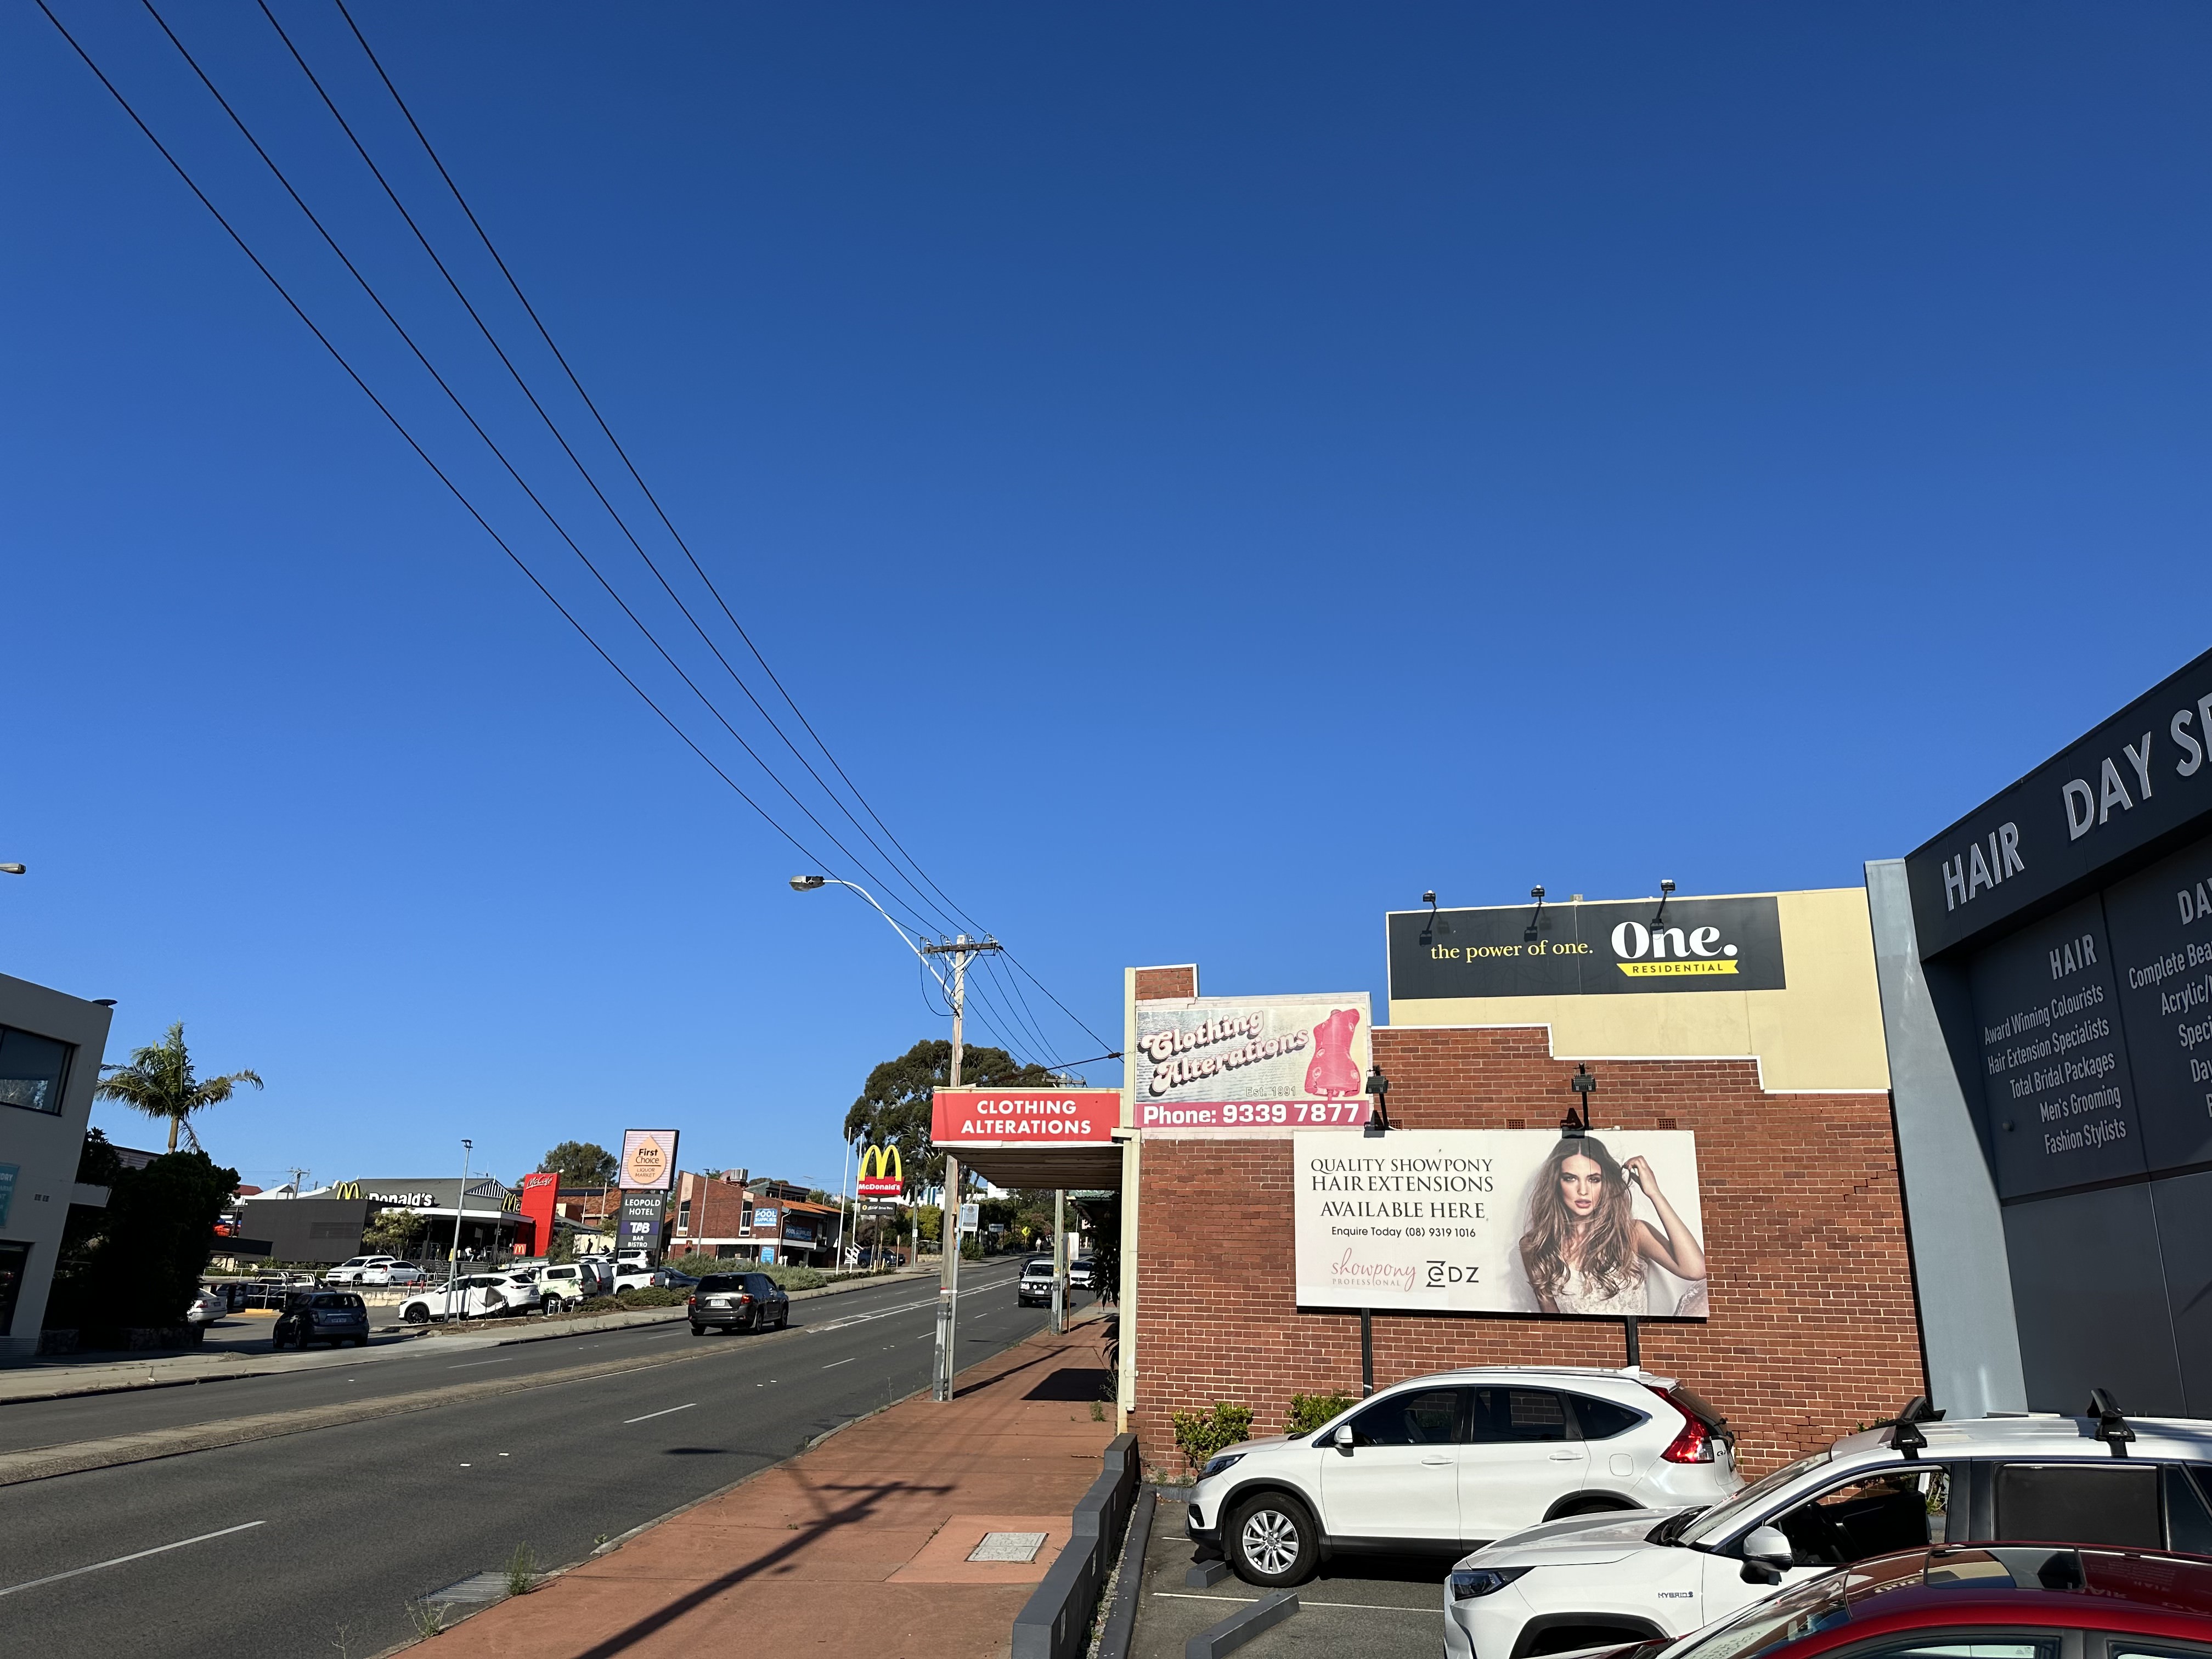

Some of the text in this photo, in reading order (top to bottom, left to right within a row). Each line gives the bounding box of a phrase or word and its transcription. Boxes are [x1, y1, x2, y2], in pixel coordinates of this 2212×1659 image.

[1942, 822, 2024, 911] HAIR
[2062, 731, 2152, 841] DAY
[1431, 940, 1593, 963] the power of one.
[1611, 921, 1738, 959] One.
[1633, 963, 1724, 973] RESIDENTIAL
[2049, 934, 2097, 980] HAIR
[2129, 941, 2212, 989] Complete Bea
[1985, 984, 2104, 1045] Award Winning Colourists
[1141, 1010, 1265, 1060] Clothing
[1988, 1018, 2109, 1075] Hair Extension Specialists
[1152, 1029, 1309, 1093] Alterations
[2010, 1053, 2115, 1098] Total Bridal Packages
[1246, 1086, 1295, 1097] Est. 1991
[2040, 1085, 2121, 1122] Men's Grooming
[977, 1100, 1076, 1115] CLOTHING
[1143, 1103, 1359, 1124] Phone: 9339 7877
[961, 1120, 1091, 1135] ALTERATIONS
[2045, 1119, 2126, 1154] Fashion Stylists
[639, 1148, 658, 1156] First
[1311, 1159, 1493, 1175] QUALITY SHOWPONY
[1312, 1176, 1493, 1192] HAIR EXTENSIONS
[1320, 1201, 1485, 1218] AVAILABLE HERE
[630, 1222, 650, 1233] TAB
[1332, 1227, 1476, 1238] Enquire Today (08) 9319 1016
[1331, 1248, 1416, 1292] showpony
